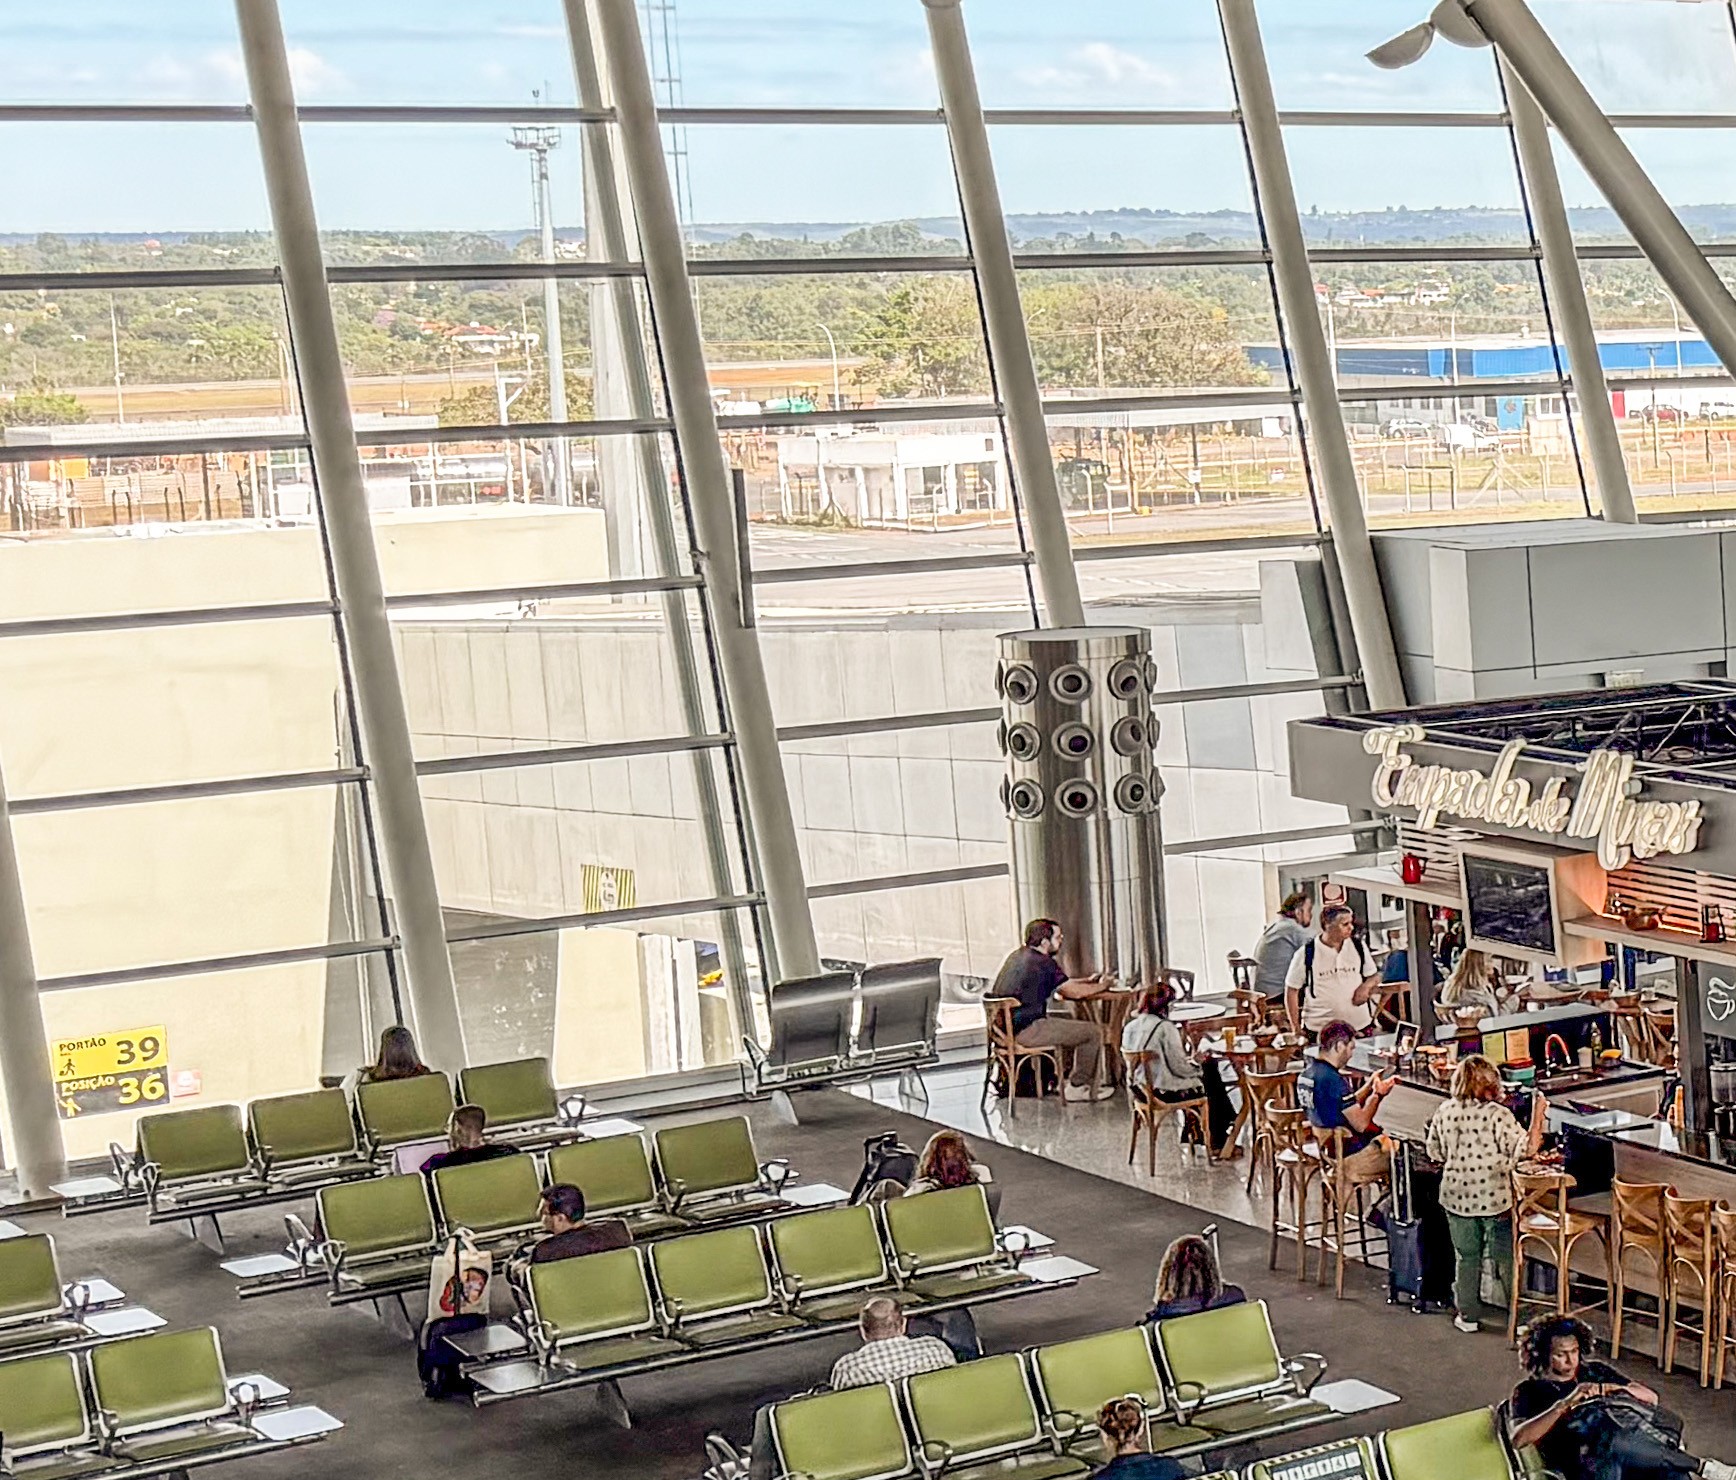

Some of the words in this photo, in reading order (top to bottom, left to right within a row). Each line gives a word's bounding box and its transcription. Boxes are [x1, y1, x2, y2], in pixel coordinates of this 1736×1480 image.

[1363, 724, 1531, 830] Empada
[1567, 749, 1703, 871] Minas
[59, 1037, 106, 1052] PORTÃO
[116, 1036, 160, 1065] 39
[61, 1075, 115, 1091] POSIÇÃO
[118, 1072, 165, 1104] 36
